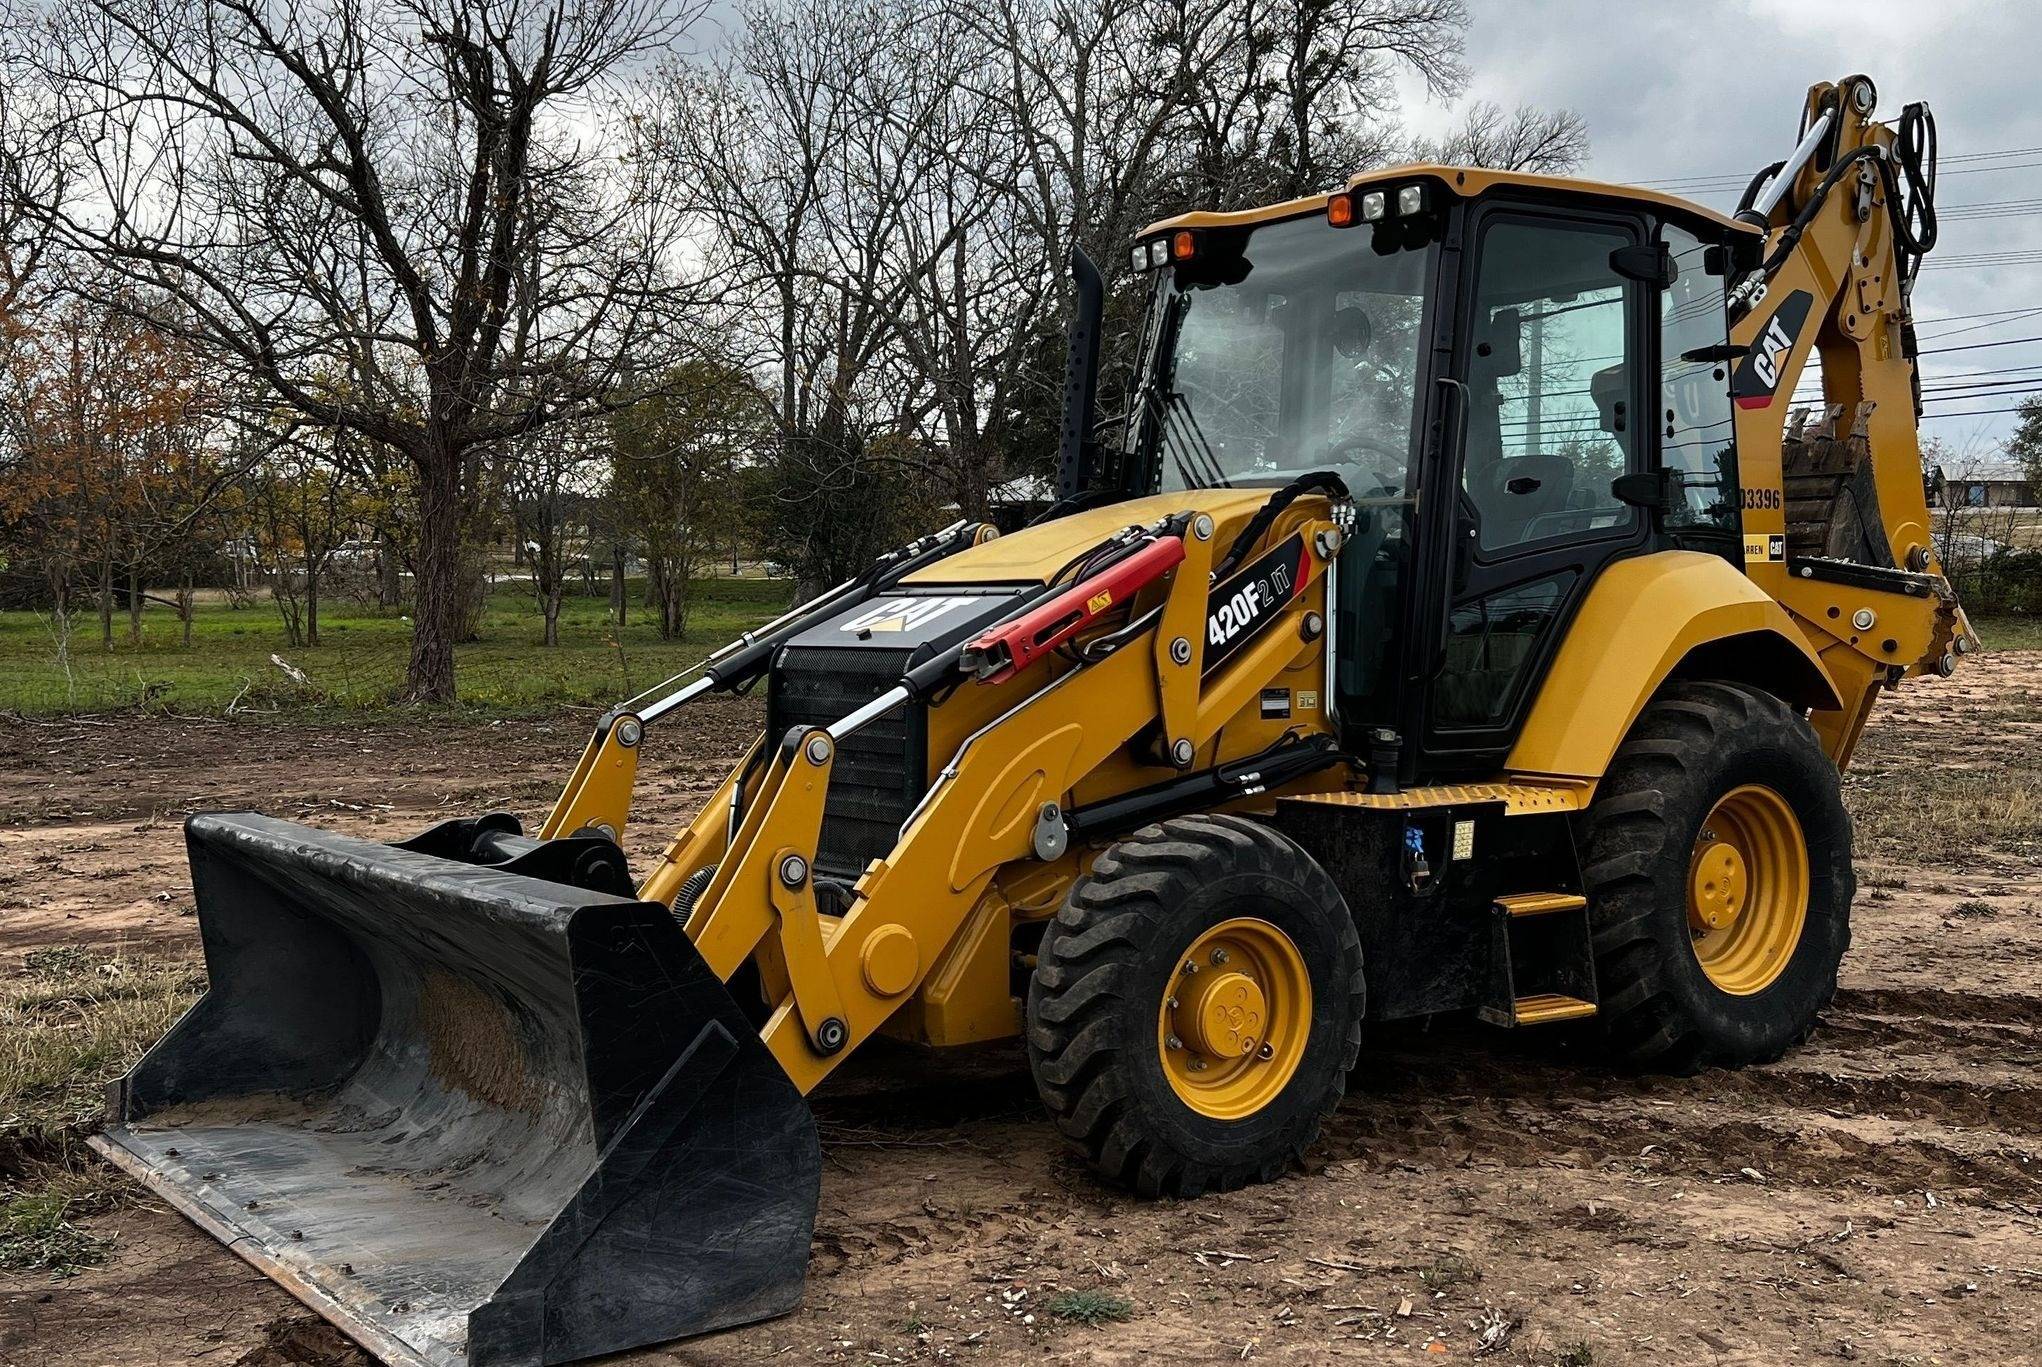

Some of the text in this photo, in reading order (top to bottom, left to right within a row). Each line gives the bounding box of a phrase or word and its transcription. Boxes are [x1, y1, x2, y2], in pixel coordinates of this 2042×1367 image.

[1754, 315, 1793, 389] CAT
[1743, 541, 1783, 555] RREN CAT
[839, 597, 980, 632] CAT
